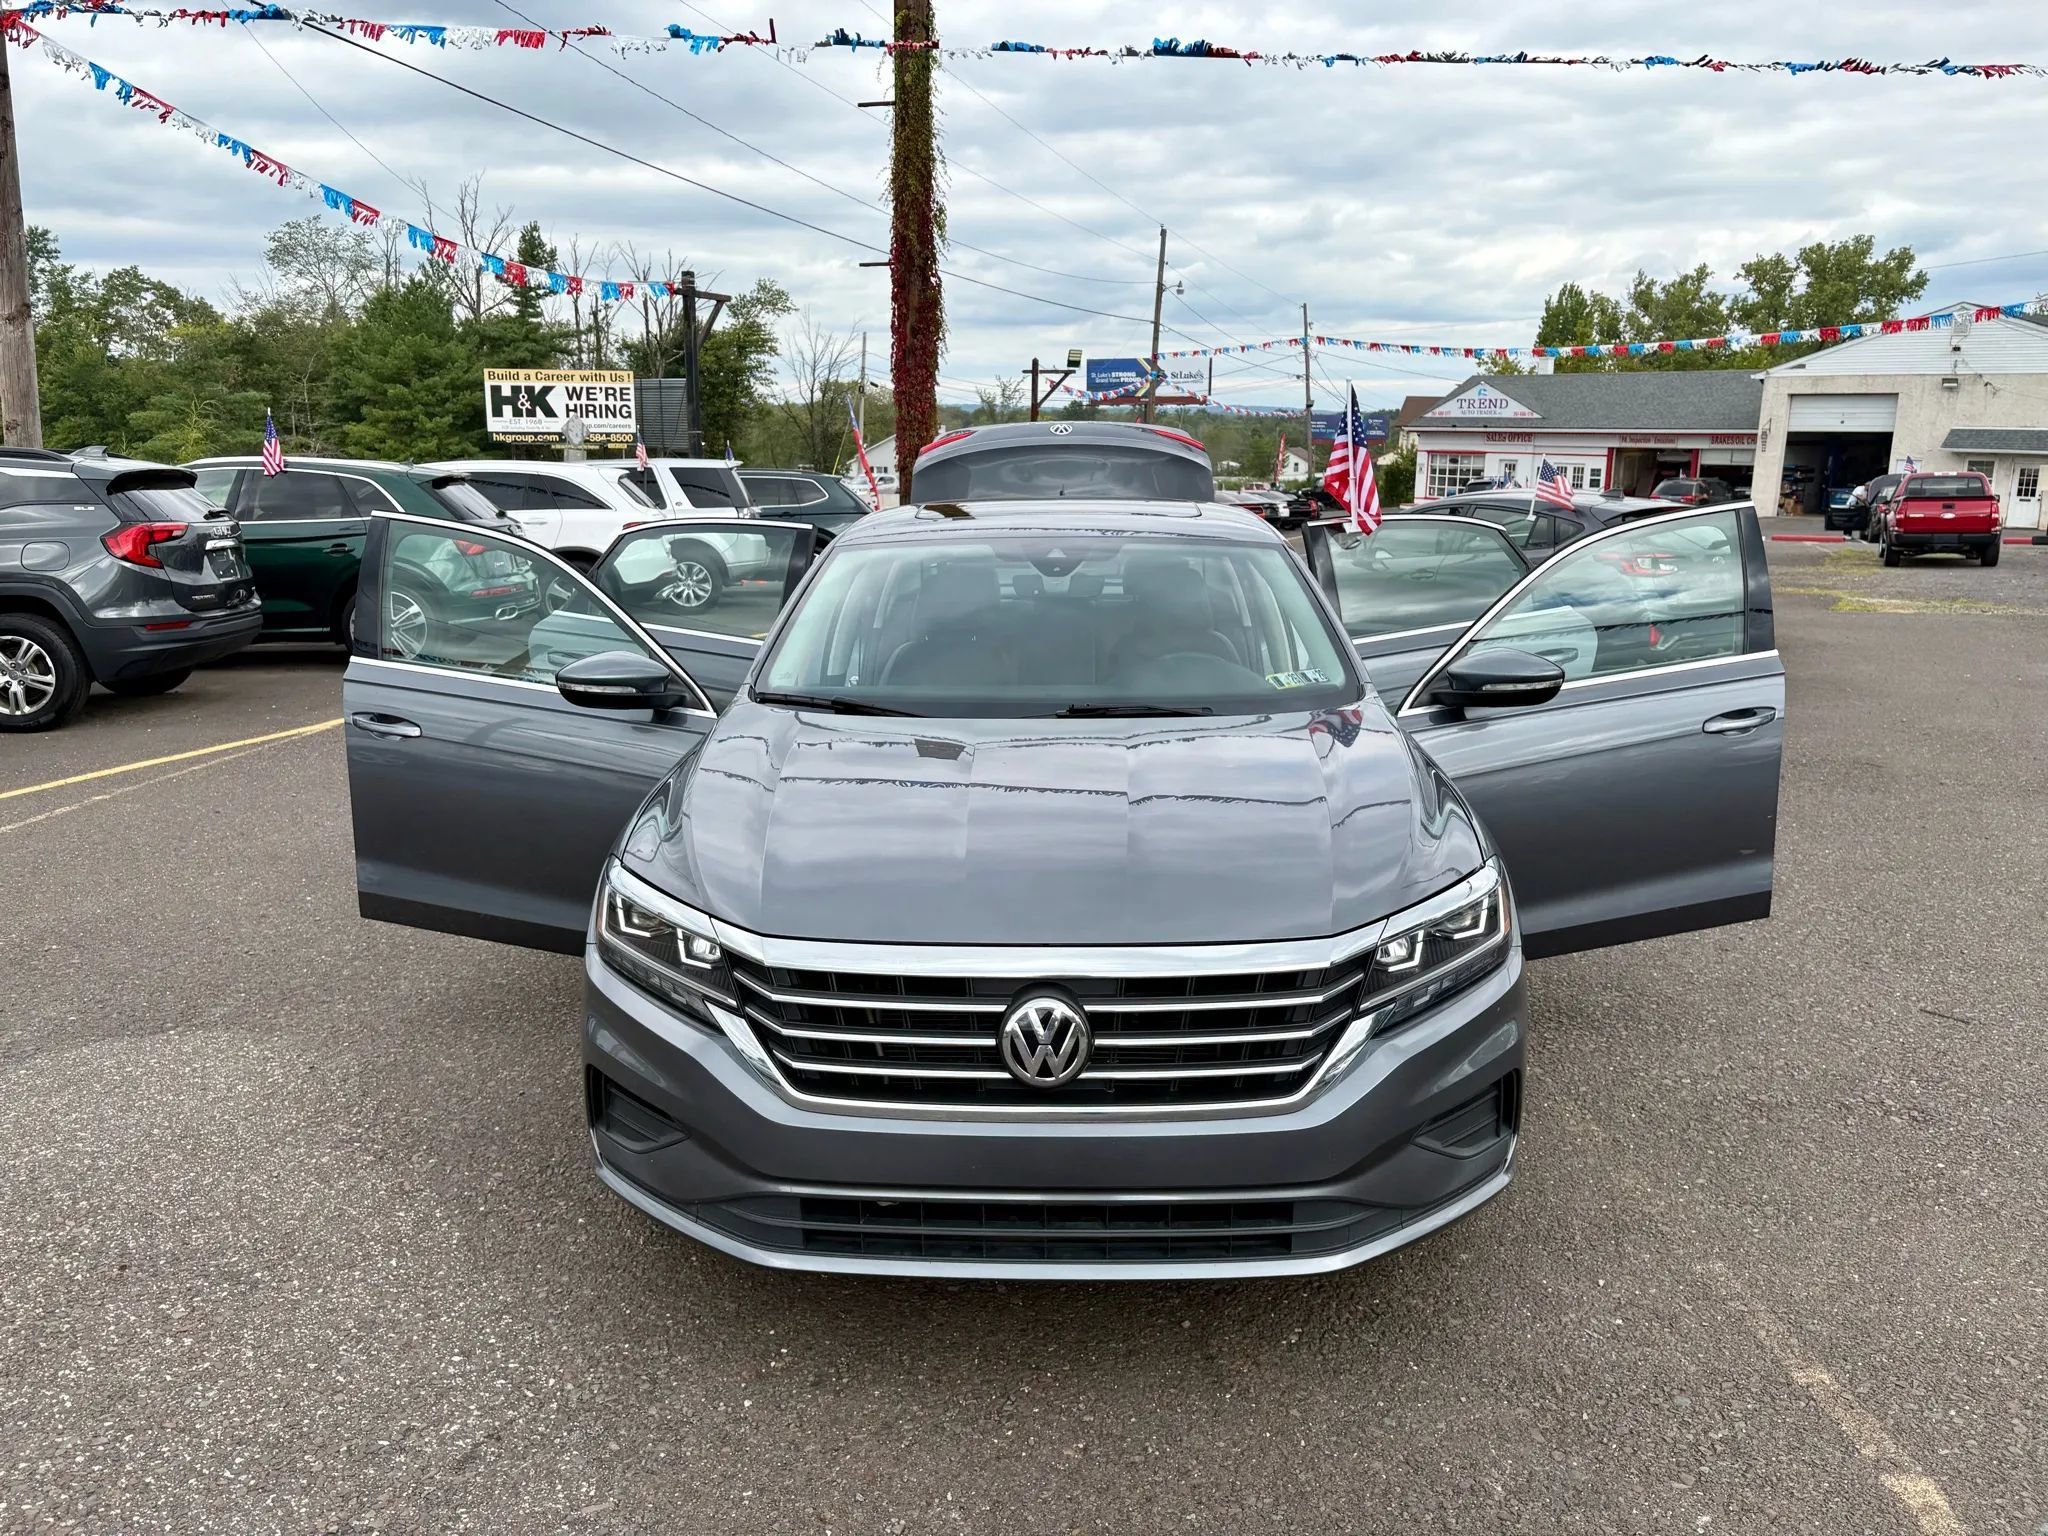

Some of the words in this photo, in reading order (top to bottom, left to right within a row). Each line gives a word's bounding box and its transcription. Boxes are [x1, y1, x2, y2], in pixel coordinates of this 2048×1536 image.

[487, 371, 520, 381] Build
[523, 372, 531, 381] a
[535, 371, 576, 382] Career
[579, 372, 606, 382] with
[565, 386, 631, 402] WE'RE
[490, 384, 559, 418] H&K
[1456, 398, 1509, 409] TREND
[565, 403, 632, 419] HIRING
[493, 433, 559, 443] hkgroup.com
[586, 433, 634, 442] -584-8500
[1486, 432, 1506, 442] SALES
[1507, 432, 1533, 443] OFFICE
[1002, 998, 1088, 1087] VW
